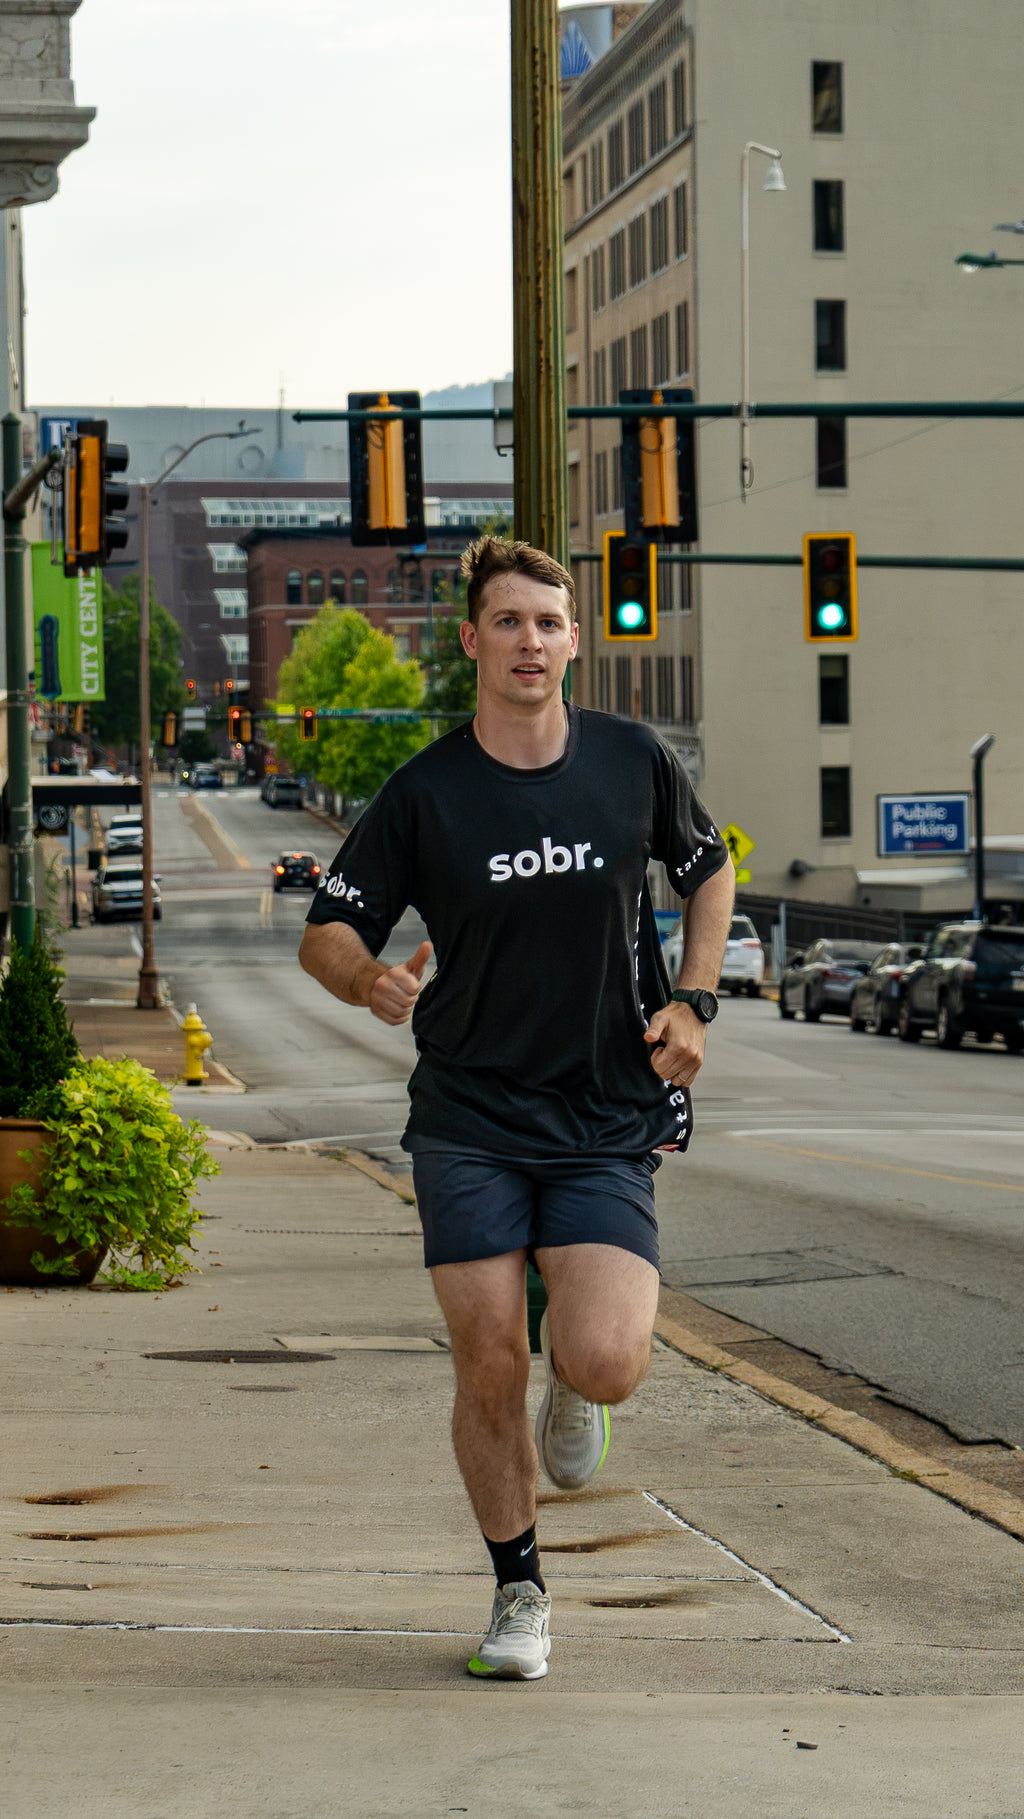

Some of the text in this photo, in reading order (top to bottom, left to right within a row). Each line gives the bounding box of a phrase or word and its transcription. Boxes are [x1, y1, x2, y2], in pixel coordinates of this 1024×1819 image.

[80, 641, 99, 695] CITY
[892, 802, 947, 820] Public
[892, 821, 958, 841] Parking
[489, 836, 604, 881] sobr.
